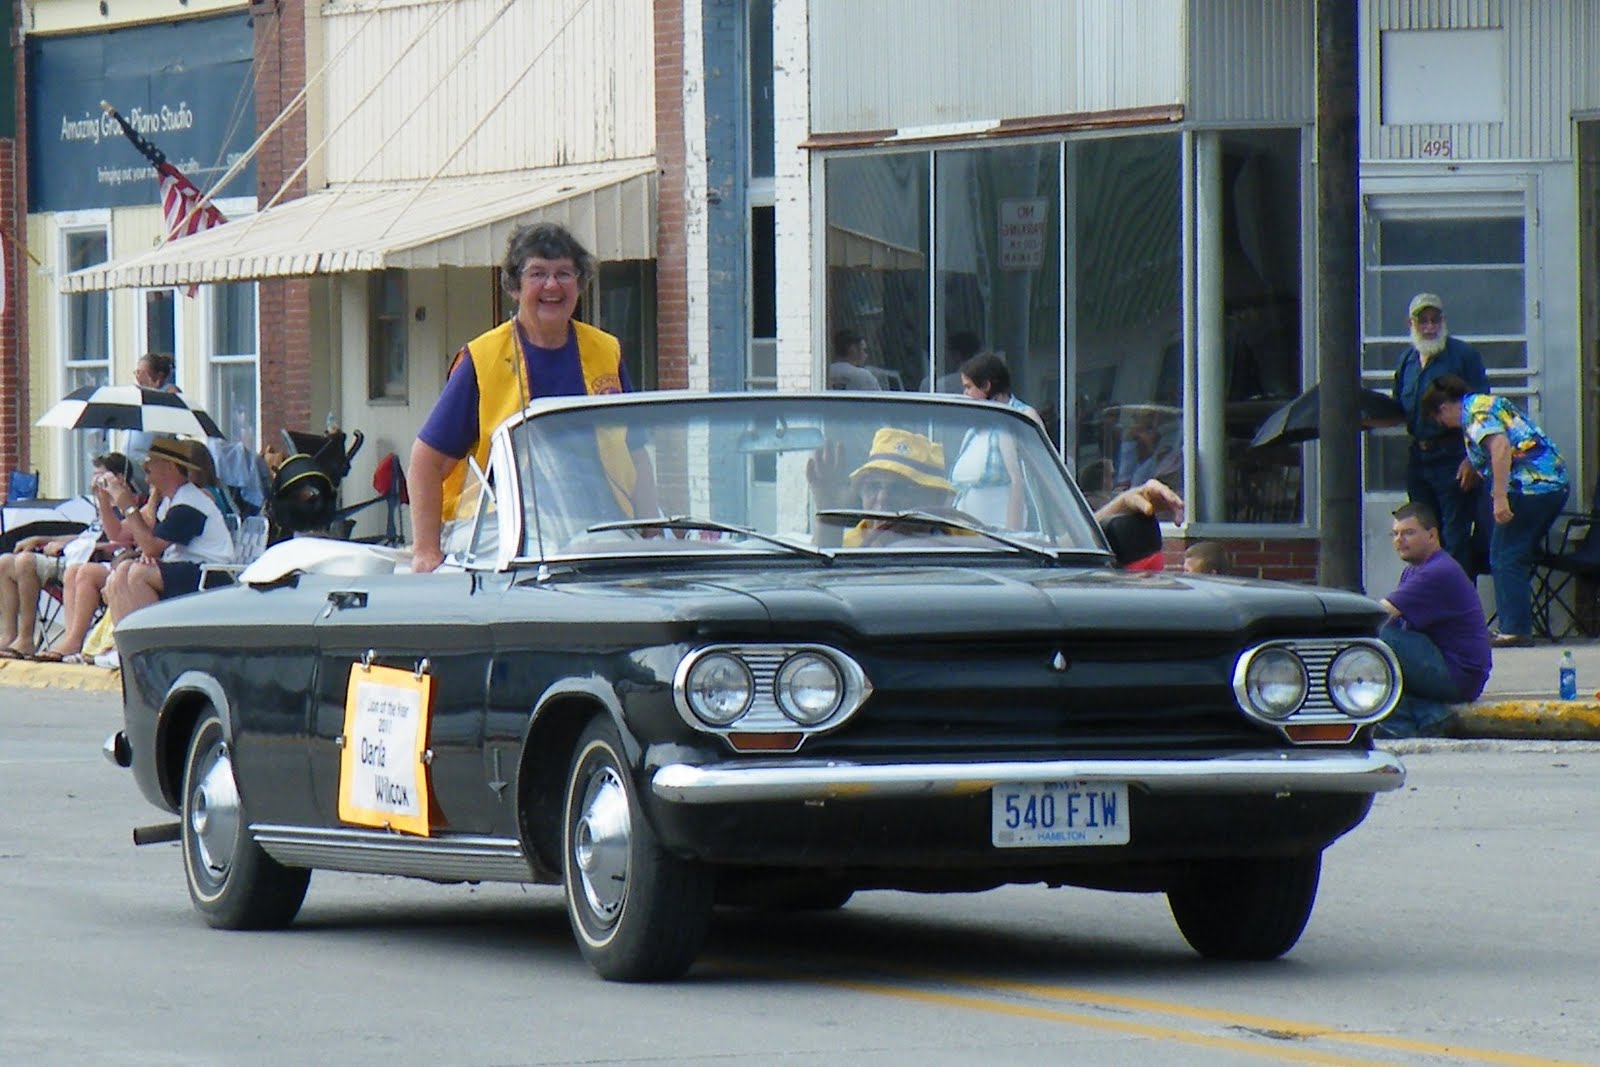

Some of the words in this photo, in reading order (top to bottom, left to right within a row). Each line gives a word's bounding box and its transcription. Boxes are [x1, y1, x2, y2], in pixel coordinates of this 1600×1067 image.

[61, 112, 99, 144] Amazing
[131, 106, 160, 133] Piano
[160, 101, 192, 131] Studio
[1423, 139, 1450, 157] 495
[361, 736, 386, 768] Darla
[374, 774, 410, 807] Wilcox
[1005, 794, 1055, 829] 540
[1067, 791, 1117, 828] FIW
[1037, 831, 1086, 841] HAMILTON
